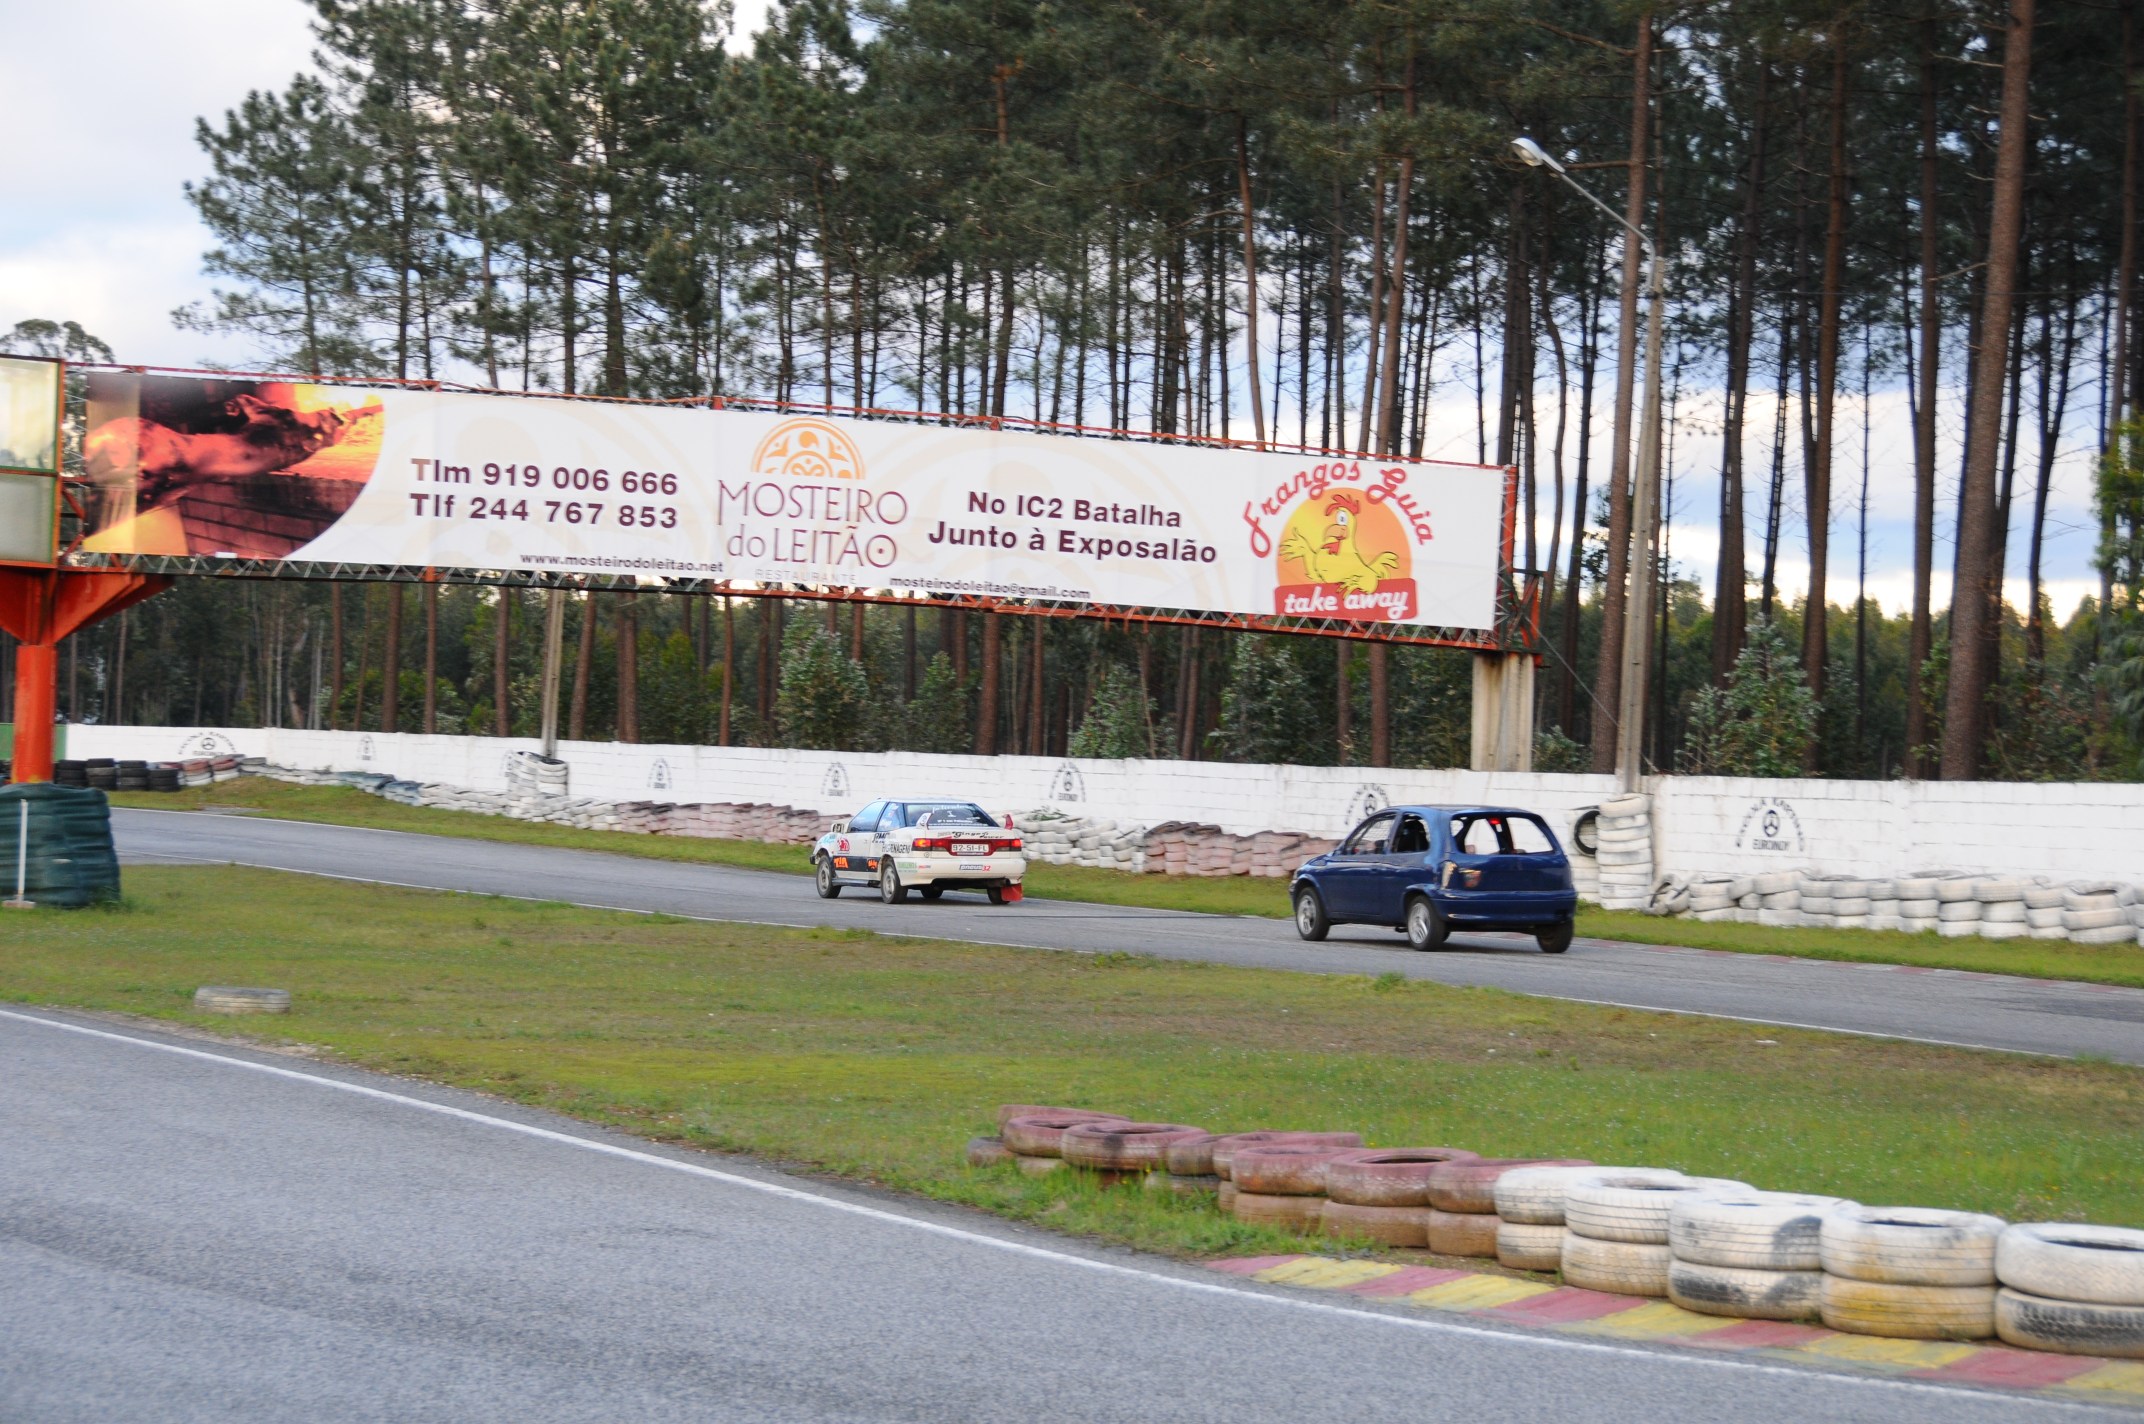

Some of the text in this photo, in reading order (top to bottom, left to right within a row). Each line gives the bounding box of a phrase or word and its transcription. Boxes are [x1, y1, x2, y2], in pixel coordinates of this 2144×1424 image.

[411, 458, 677, 496] Tlm 919 006 666
[410, 493, 677, 529] Tlf 244 767 853
[716, 480, 908, 526] MOSTEIRO
[969, 491, 1181, 528] No IC2 Batalha
[1242, 461, 1361, 559] Frangos
[727, 524, 897, 568] do LEITÃO
[929, 521, 1216, 564] Junto à Exposalão
[520, 553, 723, 573] www.mosteirodoleitao.net
[755, 569, 857, 585] RESTAURANTE
[889, 575, 1091, 600] mosteirodoleitao@gmail.com
[1284, 586, 1408, 619] take away
